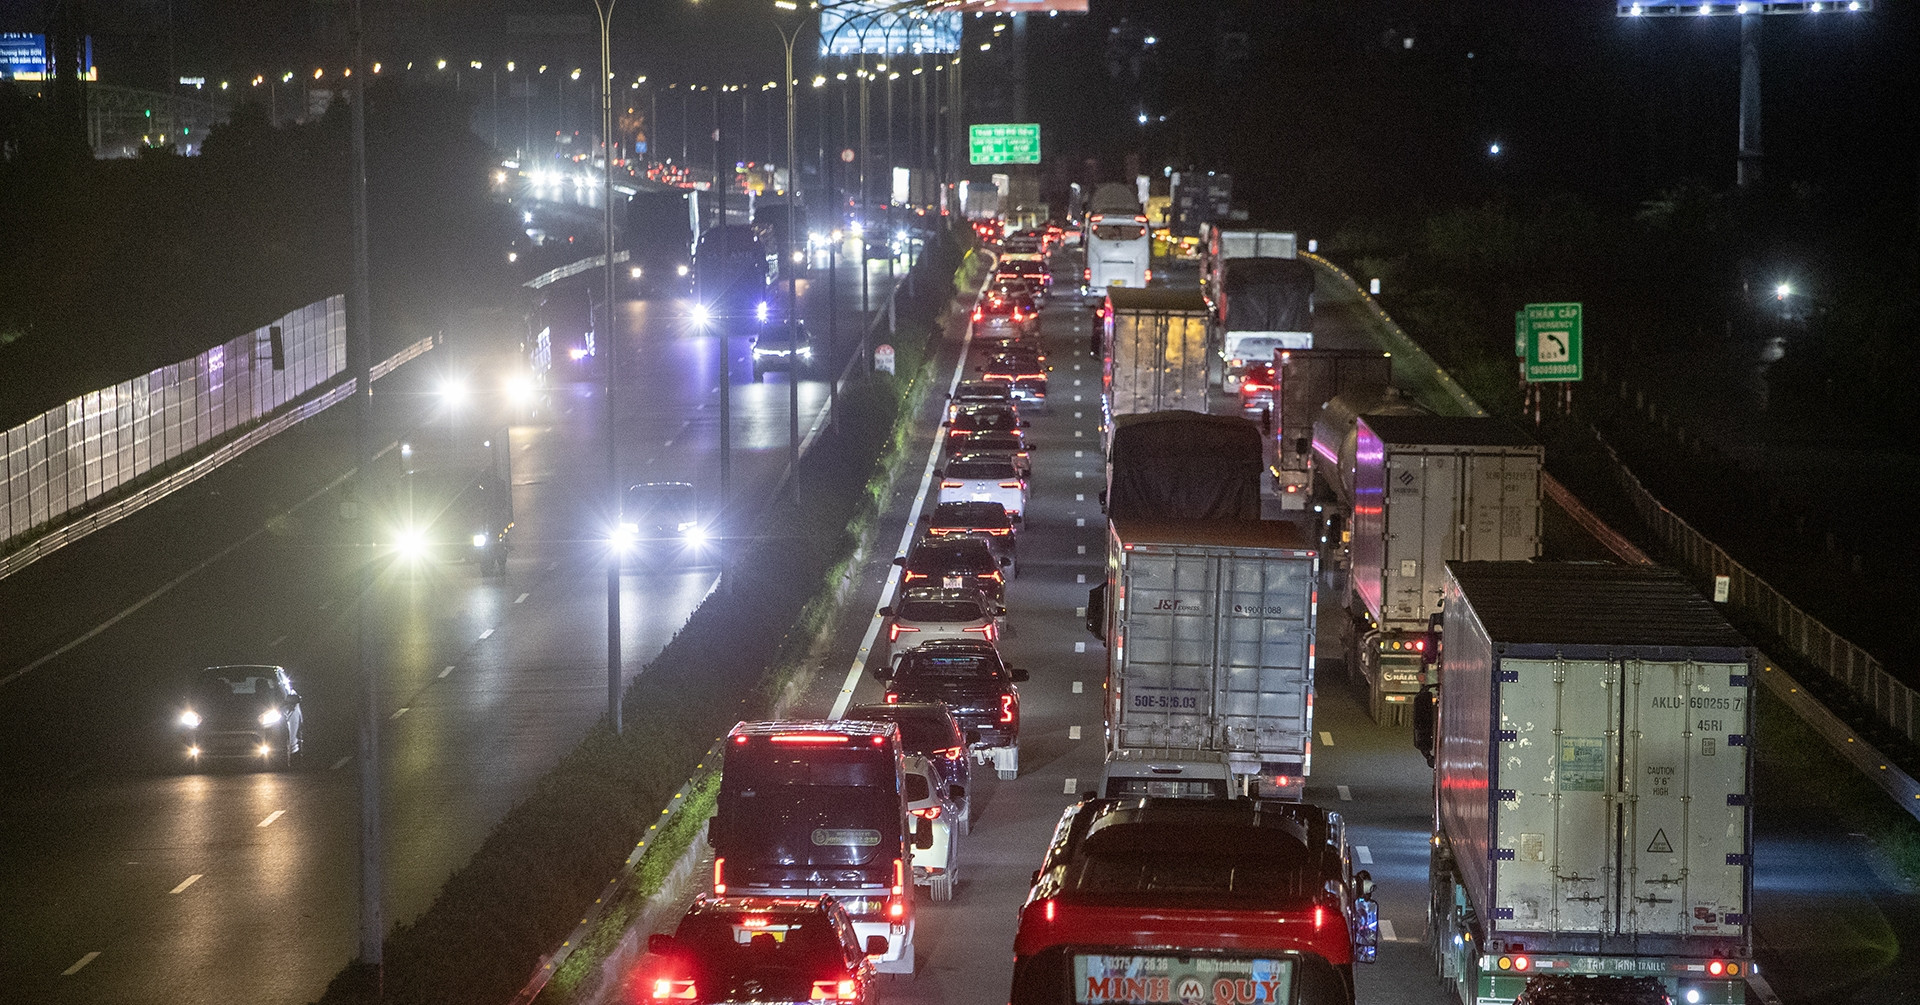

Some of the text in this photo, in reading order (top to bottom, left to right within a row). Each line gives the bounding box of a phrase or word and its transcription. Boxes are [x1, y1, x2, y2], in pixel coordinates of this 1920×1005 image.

[1153, 599, 1182, 610] J&T
[1690, 697, 1730, 710] 690255
[1647, 766, 1675, 775] CAUTION
[1652, 787, 1669, 796] HIGH
[1086, 976, 1171, 1003] MINH
[1212, 974, 1282, 1005] QUÝ
